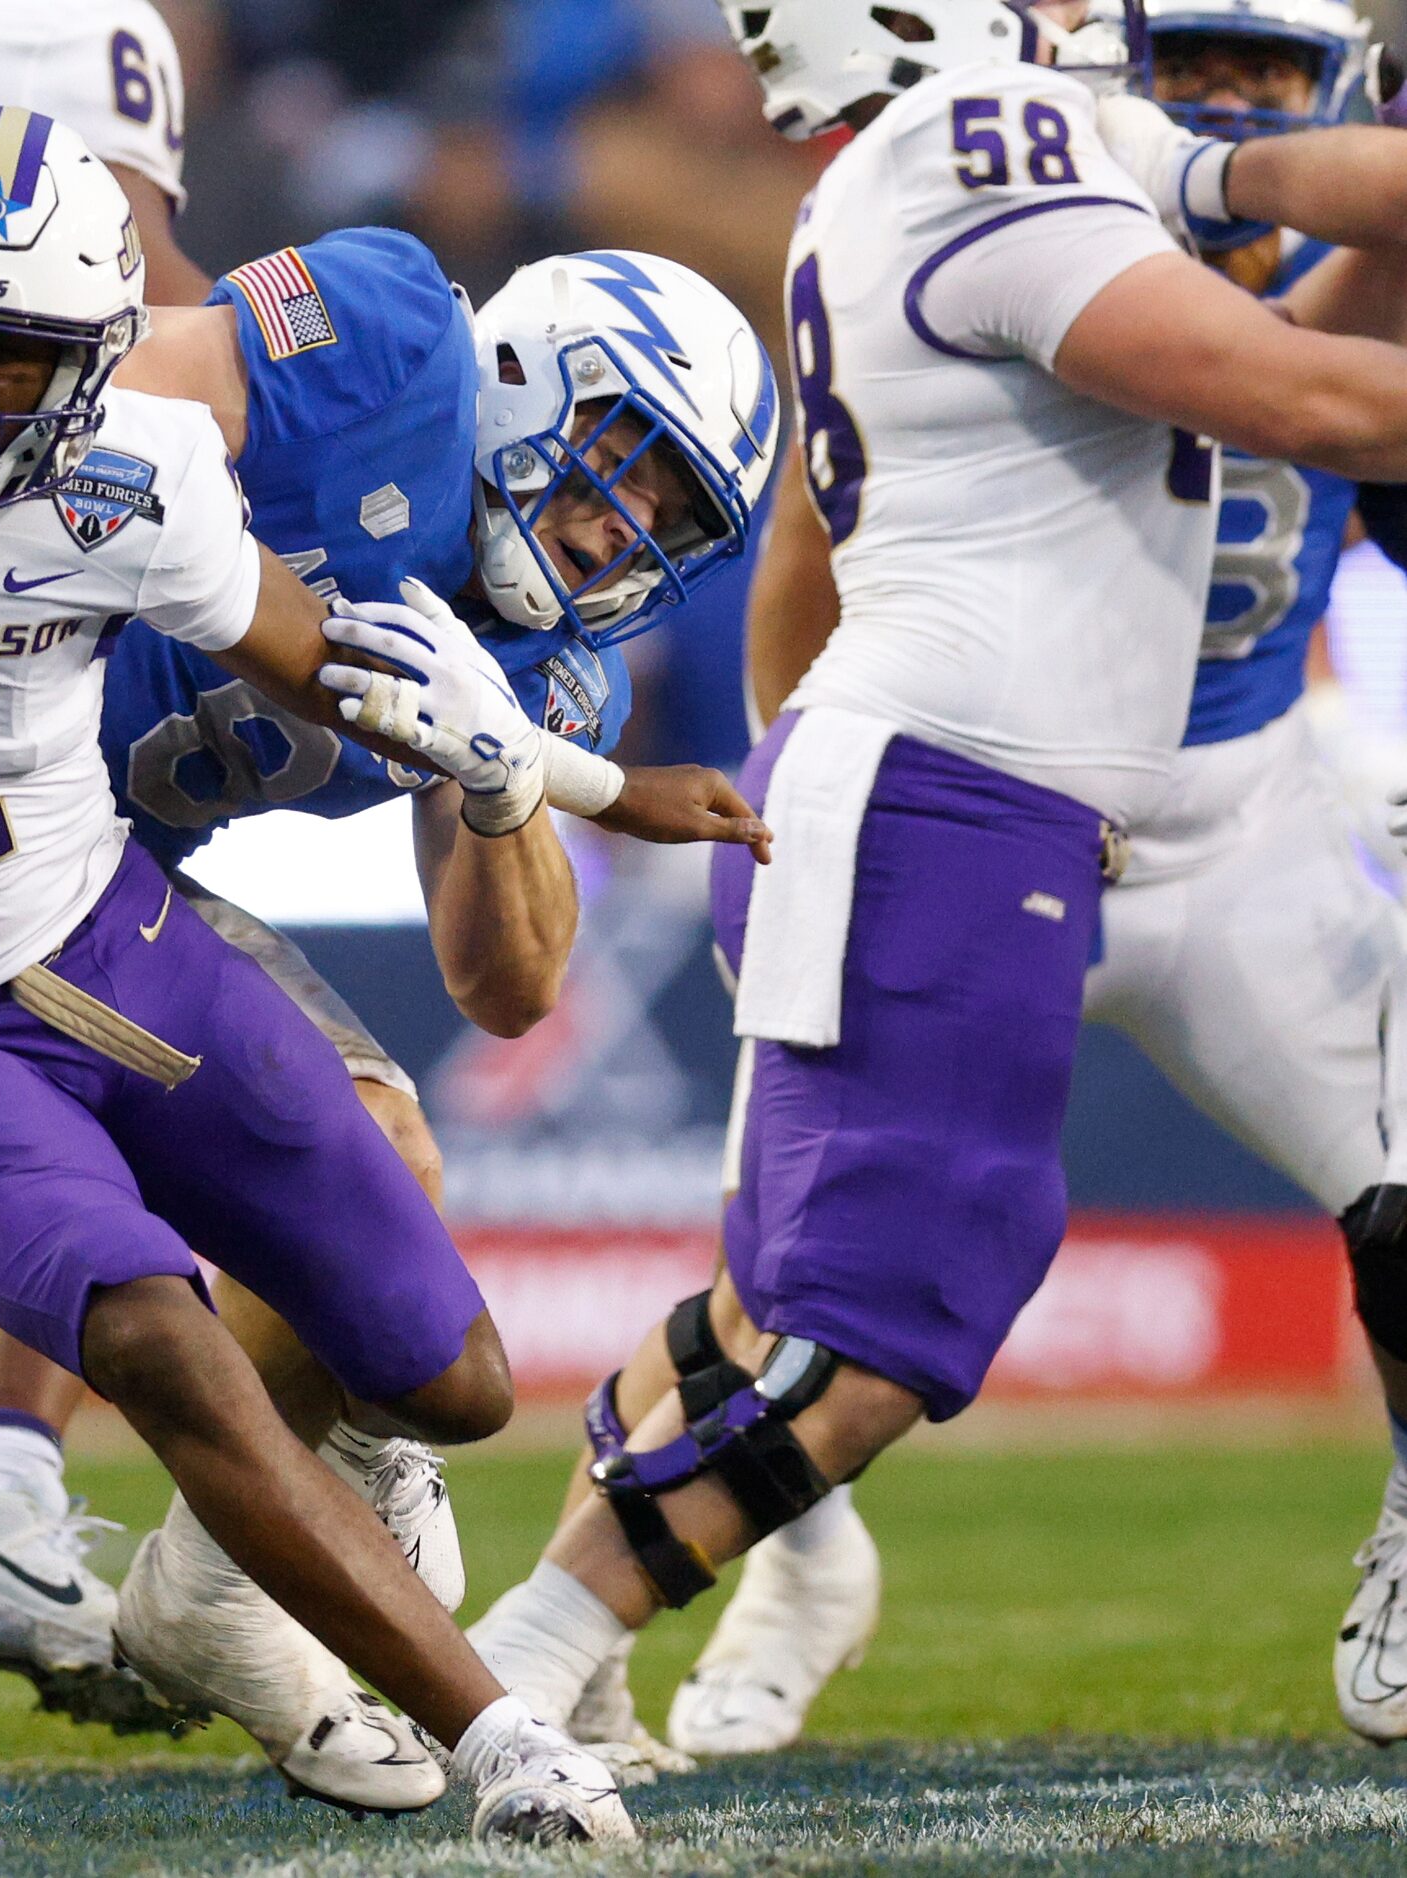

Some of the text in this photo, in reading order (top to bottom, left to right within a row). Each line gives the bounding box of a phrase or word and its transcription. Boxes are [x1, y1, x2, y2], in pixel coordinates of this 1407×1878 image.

[949, 95, 1083, 192] 58
[74, 498, 114, 514] BOWL
[96, 481, 153, 510] FORCES
